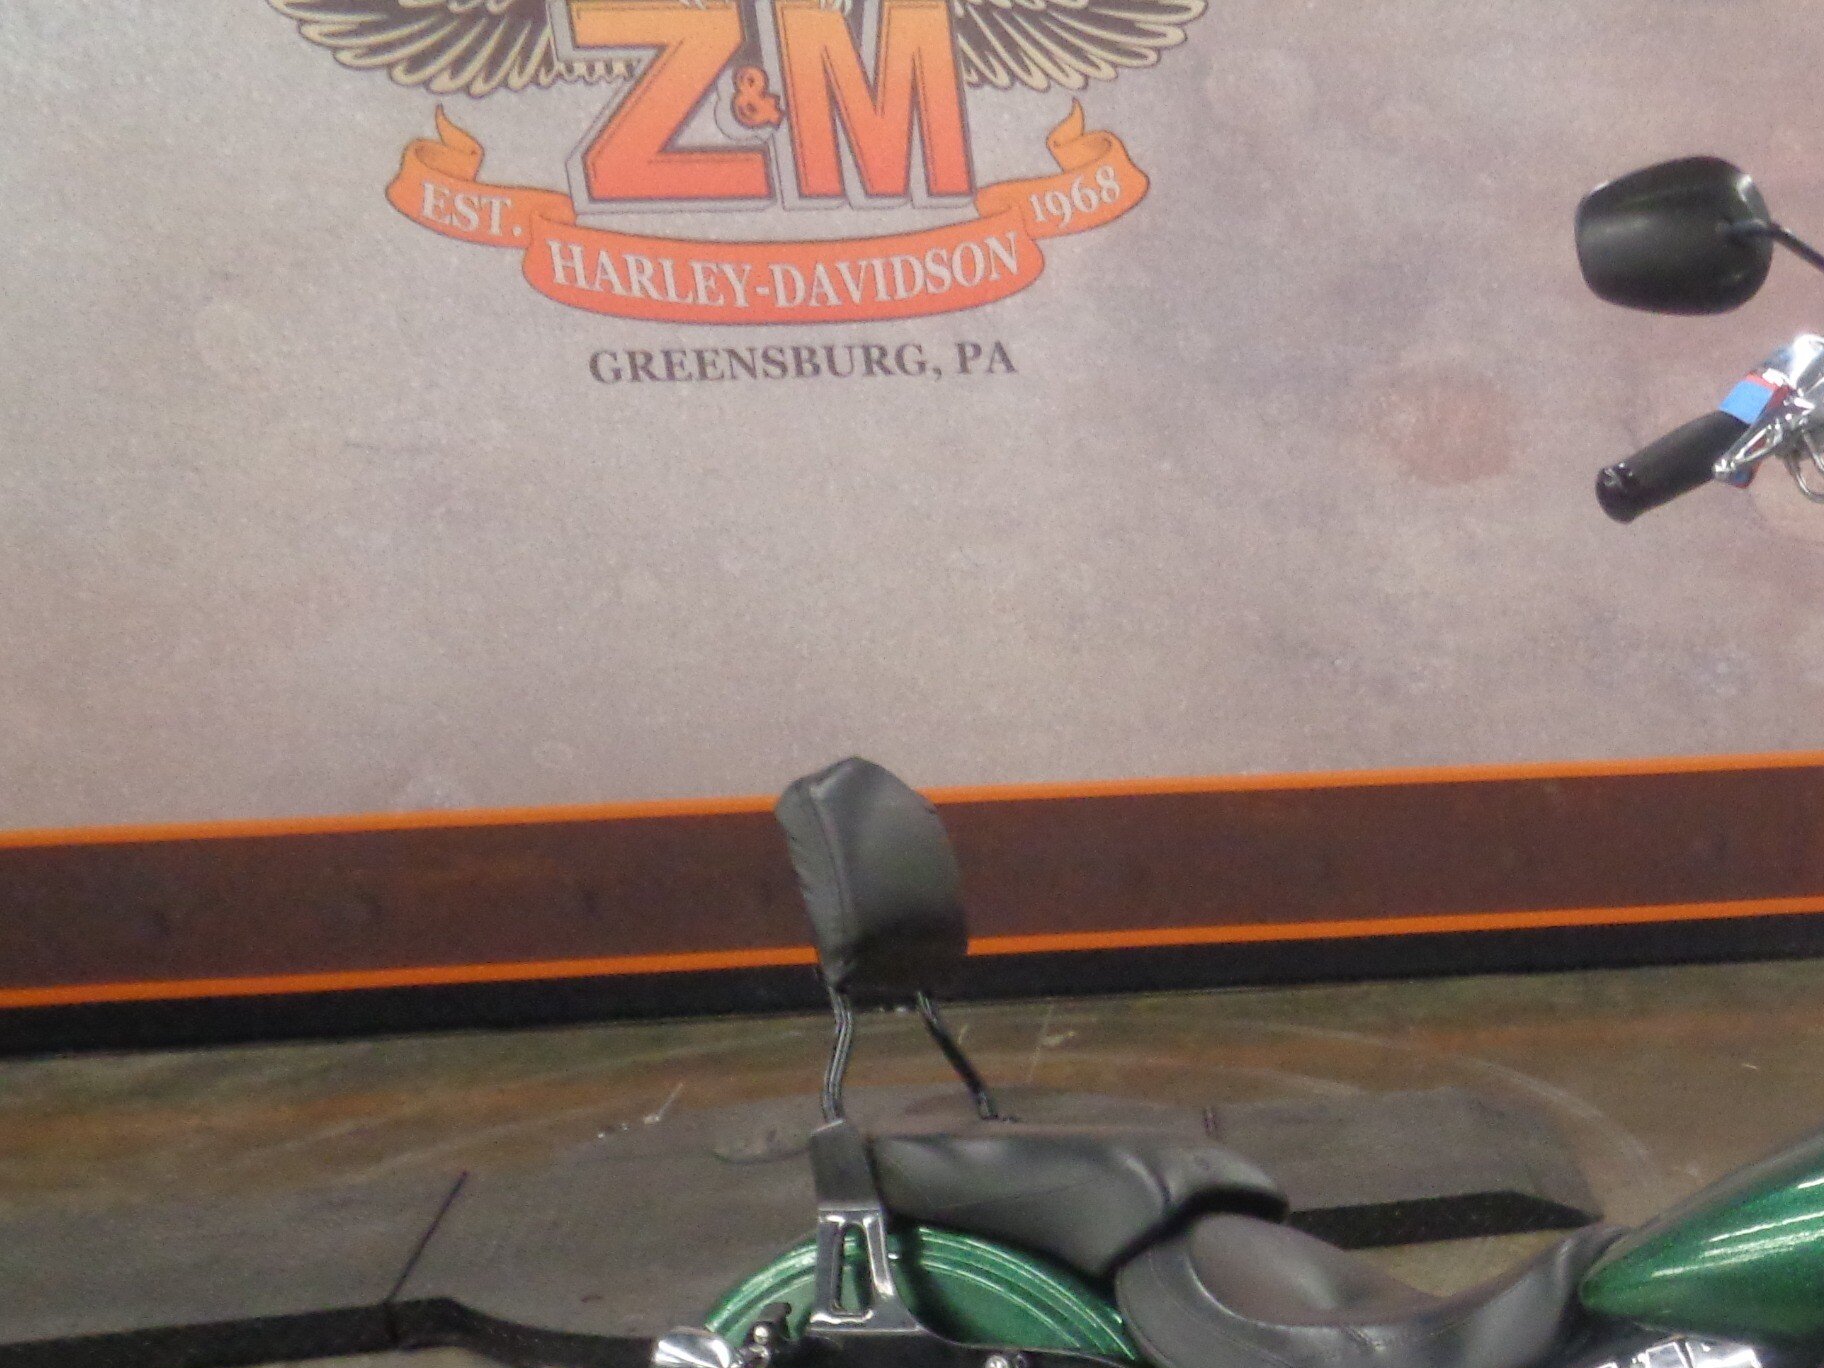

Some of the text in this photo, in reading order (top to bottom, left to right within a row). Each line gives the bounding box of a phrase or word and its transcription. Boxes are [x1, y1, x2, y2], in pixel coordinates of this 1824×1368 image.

[572, 0, 976, 203] Z&M
[421, 181, 523, 238] EST.
[1029, 164, 1121, 230] 1968
[546, 230, 1019, 309] HARLEY-DAVIDSON
[588, 340, 1018, 385] GREENSBURG, PA
